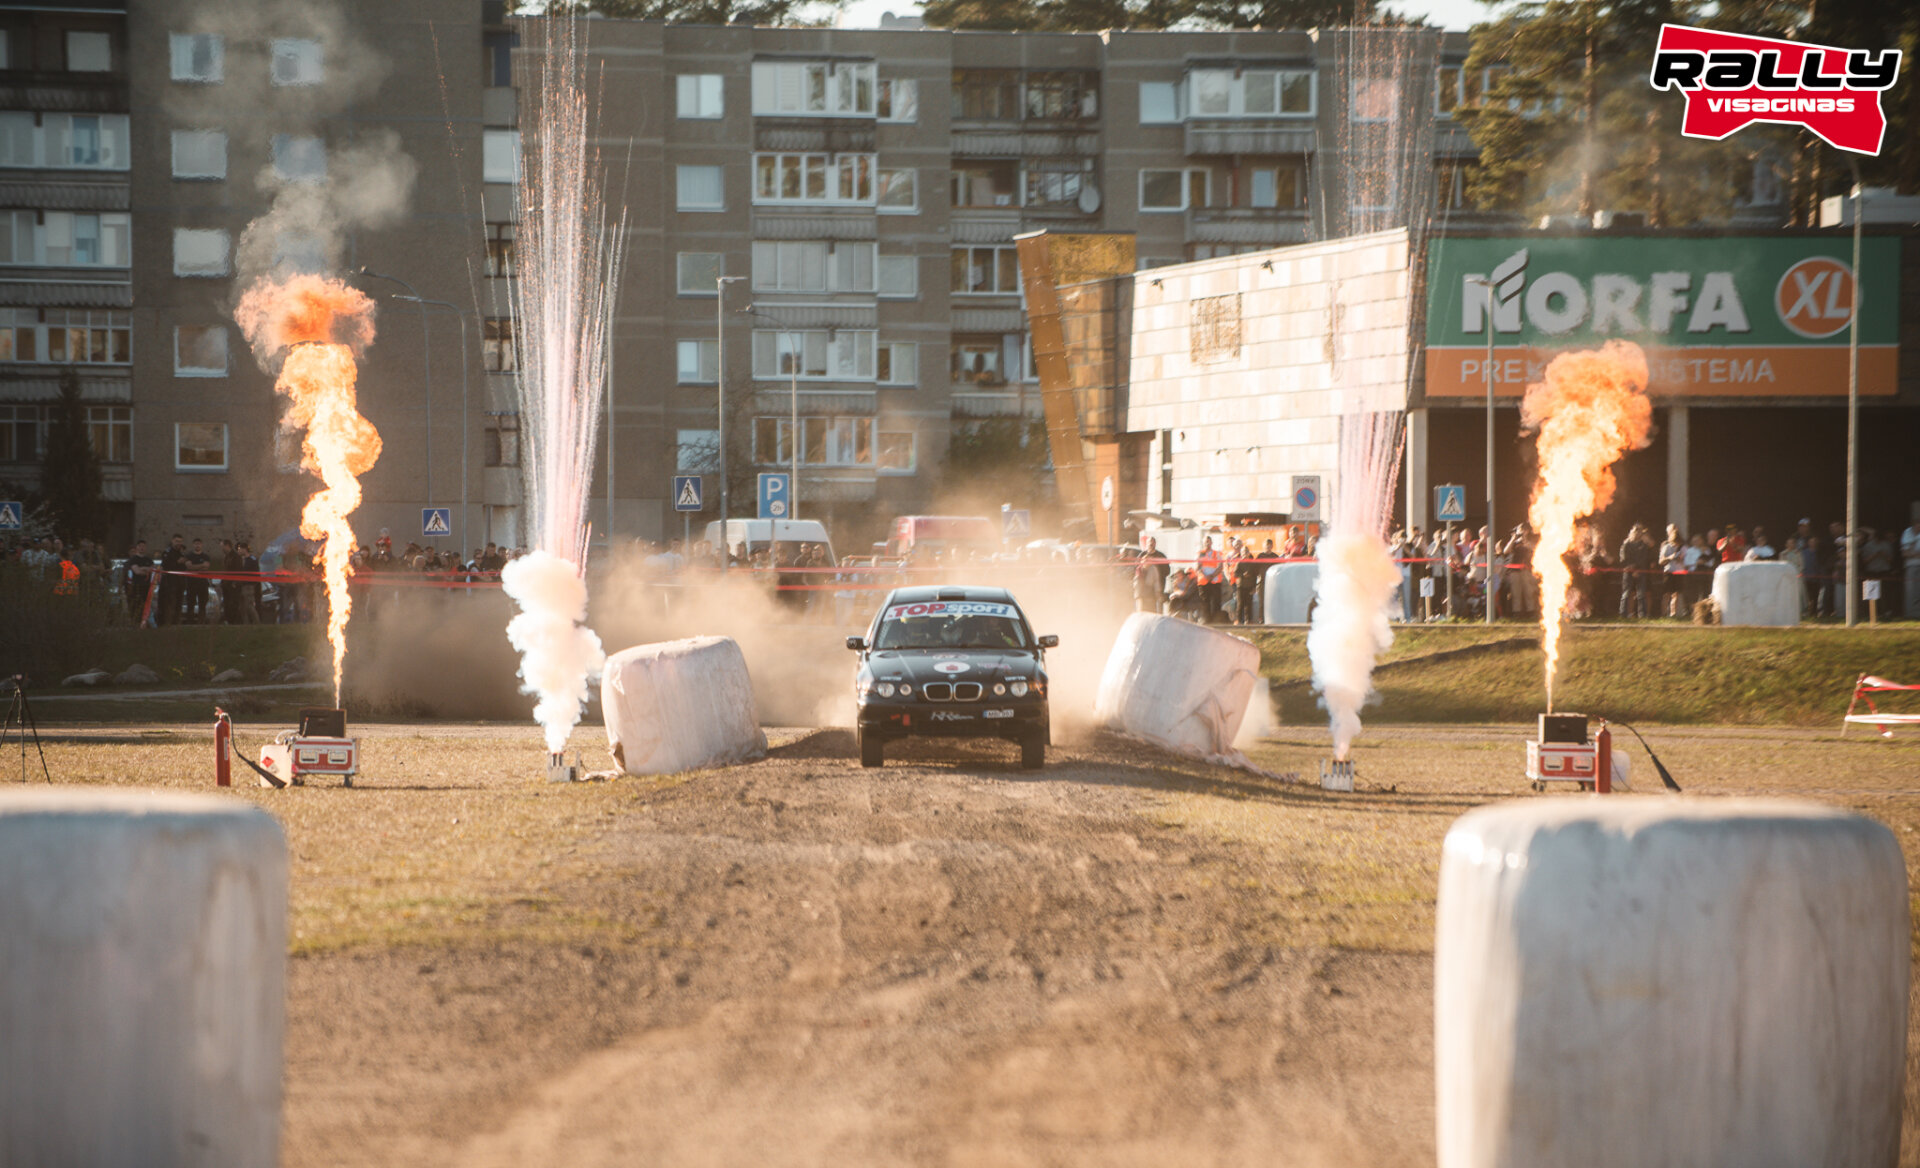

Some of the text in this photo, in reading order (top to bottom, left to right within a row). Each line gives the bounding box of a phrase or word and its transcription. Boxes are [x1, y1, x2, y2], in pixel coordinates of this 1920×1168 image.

[1461, 249, 1853, 334] NORFA XL
[767, 477, 783, 500] P
